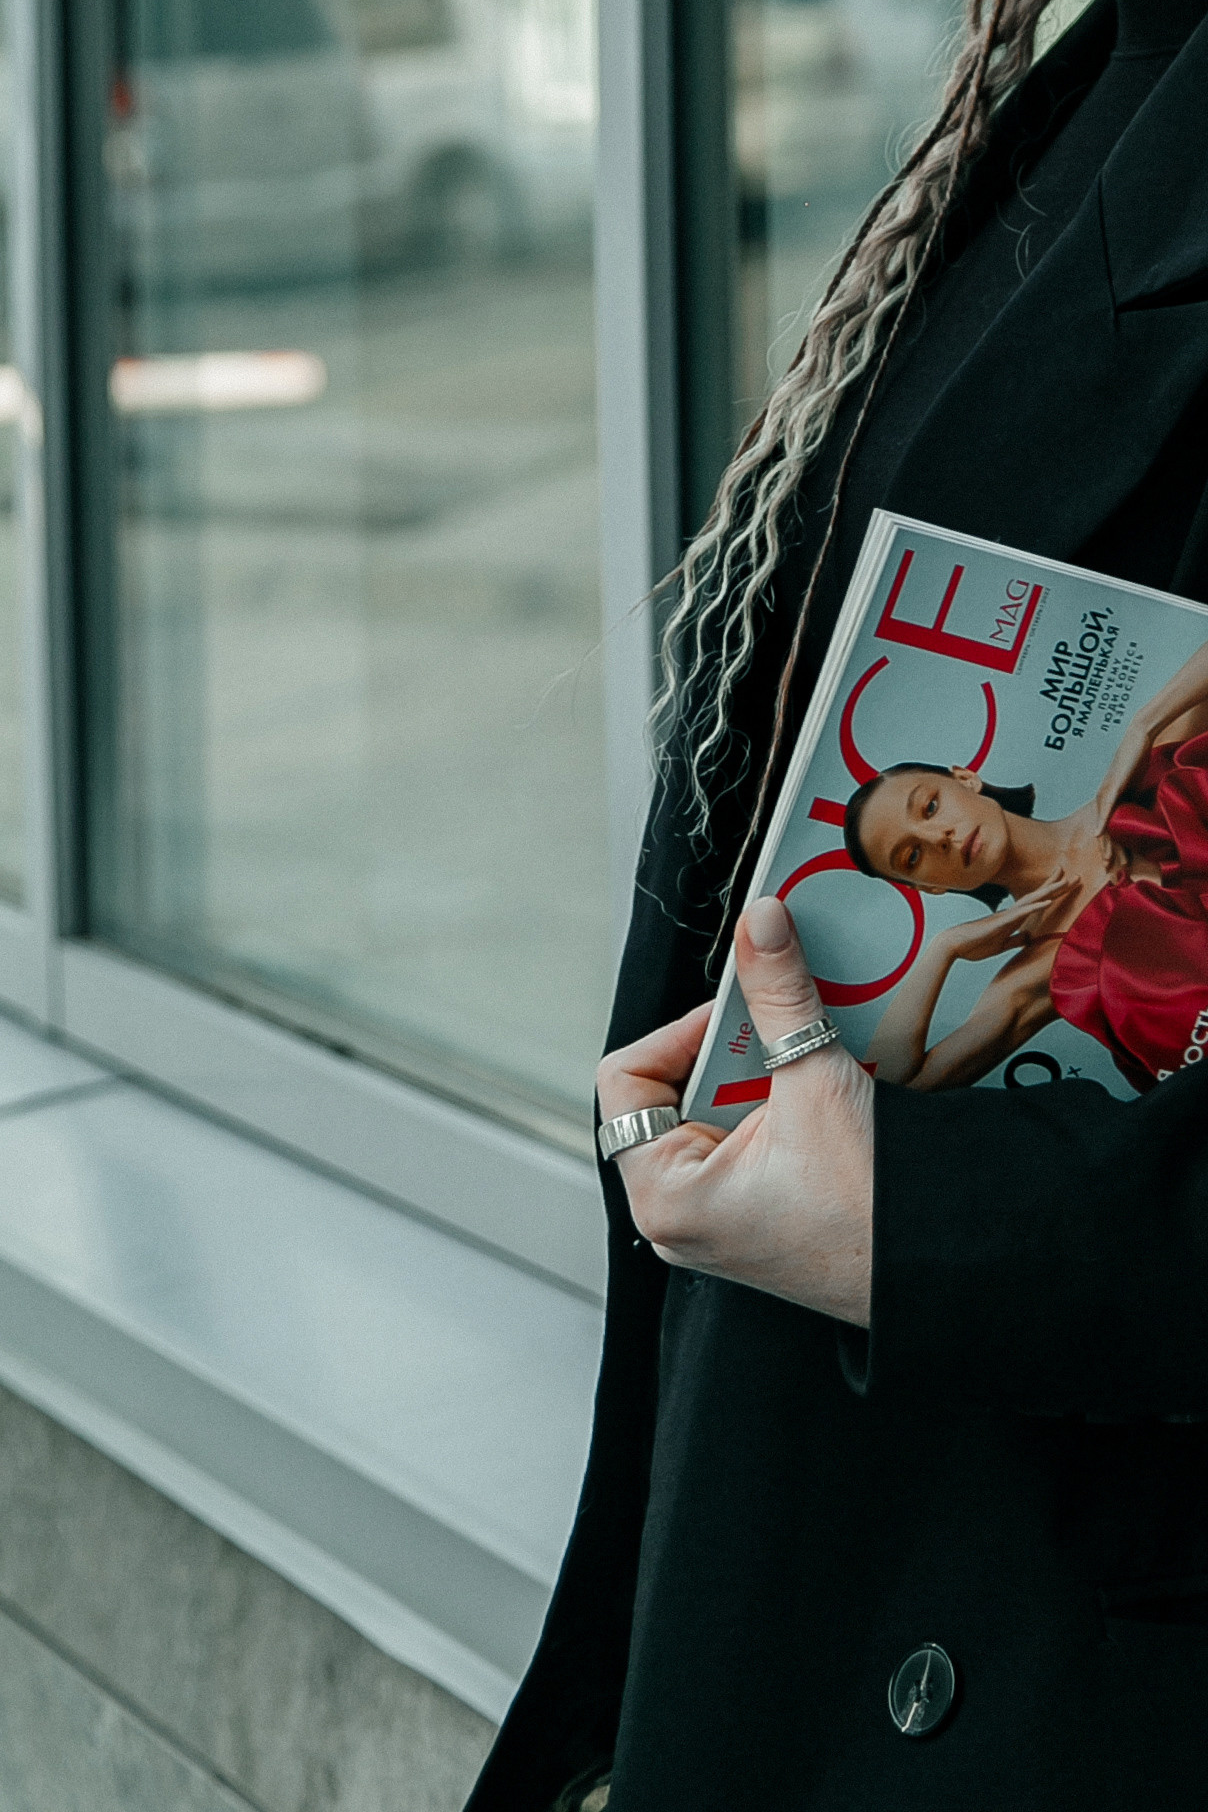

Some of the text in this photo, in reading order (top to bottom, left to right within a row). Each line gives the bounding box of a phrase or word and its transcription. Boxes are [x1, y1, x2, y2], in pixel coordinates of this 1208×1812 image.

[991, 581, 1029, 639] MAG
[1040, 641, 1073, 701] МИР
[1045, 607, 1113, 750] БОЛЬШОЙ,
[1072, 626, 1119, 737] Я МАЛЕНЬКАЯ
[1098, 658, 1121, 710] ПОЧЕМУ
[1101, 642, 1137, 732] ЛЮДИ БОЯТСЯ
[1113, 655, 1143, 724] ВЗРОСЛЕТЬ
[729, 1023, 752, 1054] the
